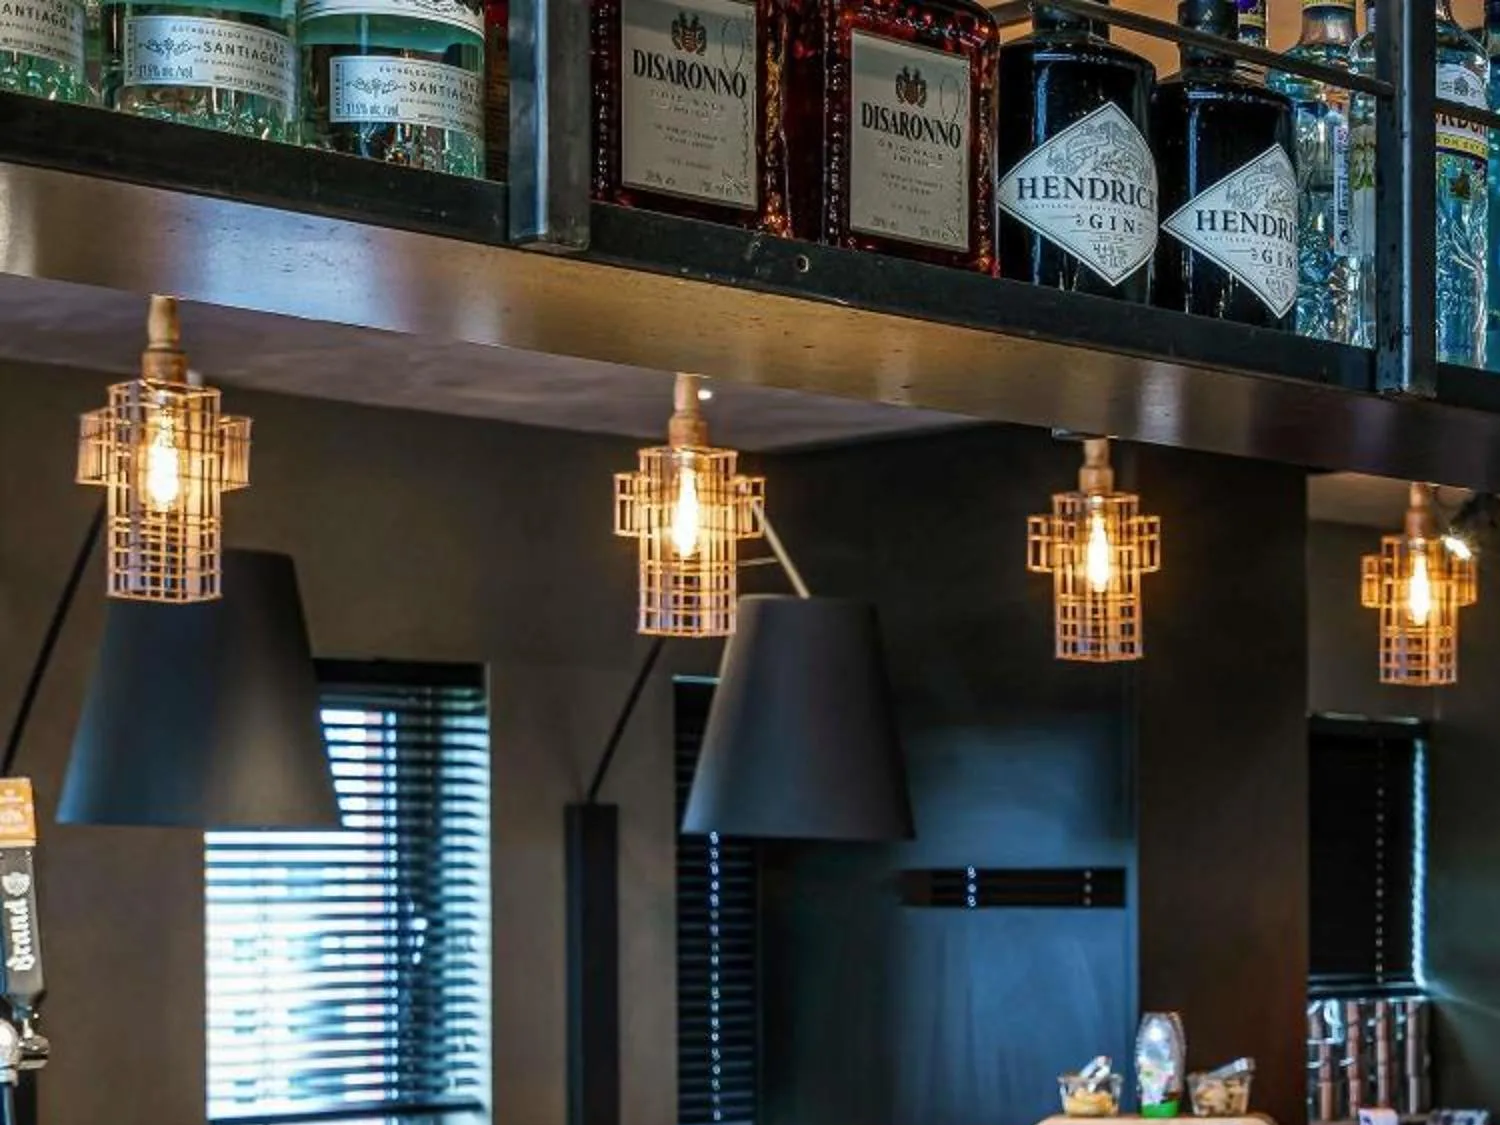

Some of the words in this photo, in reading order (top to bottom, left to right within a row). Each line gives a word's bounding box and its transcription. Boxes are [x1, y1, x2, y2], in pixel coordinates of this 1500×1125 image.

[2, 3, 67, 28] ANTIAGO
[203, 41, 277, 66] SANTIAGO
[632, 48, 747, 100] DISARONNO
[861, 102, 962, 149] DISARONNO
[1089, 213, 1136, 235] GIN
[1196, 208, 1294, 244] HENDRI
